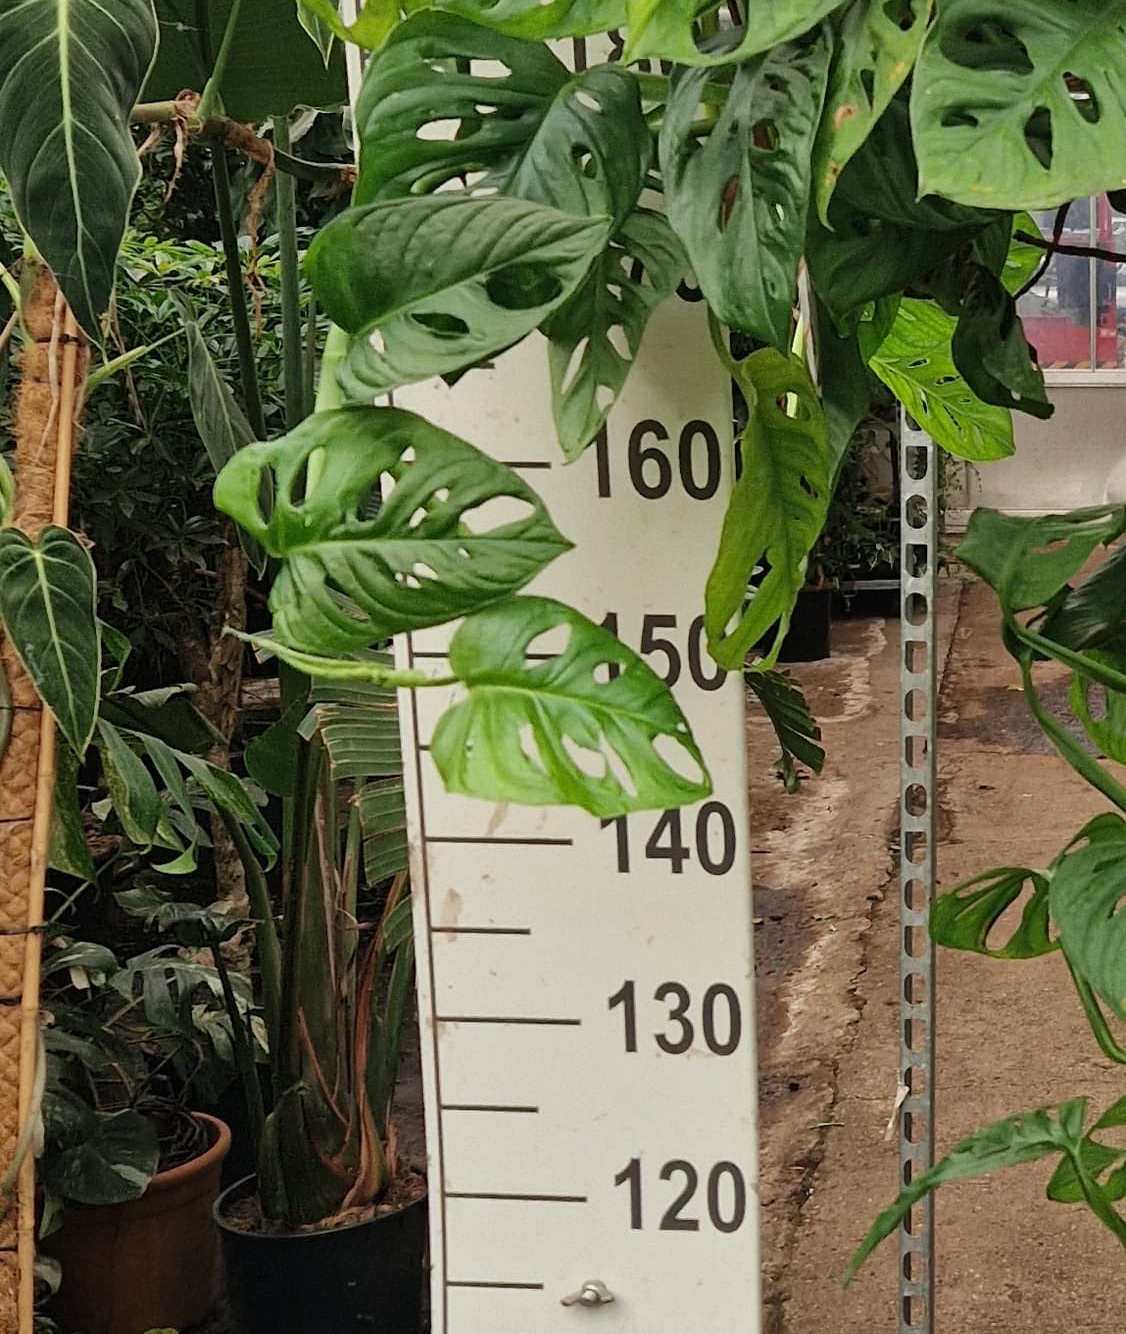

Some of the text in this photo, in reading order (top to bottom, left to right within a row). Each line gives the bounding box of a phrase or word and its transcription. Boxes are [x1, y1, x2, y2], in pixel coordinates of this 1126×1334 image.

[589, 418, 722, 501] 160
[600, 800, 737, 876] 140
[607, 980, 742, 1057] 130
[614, 1158, 747, 1234] 120
